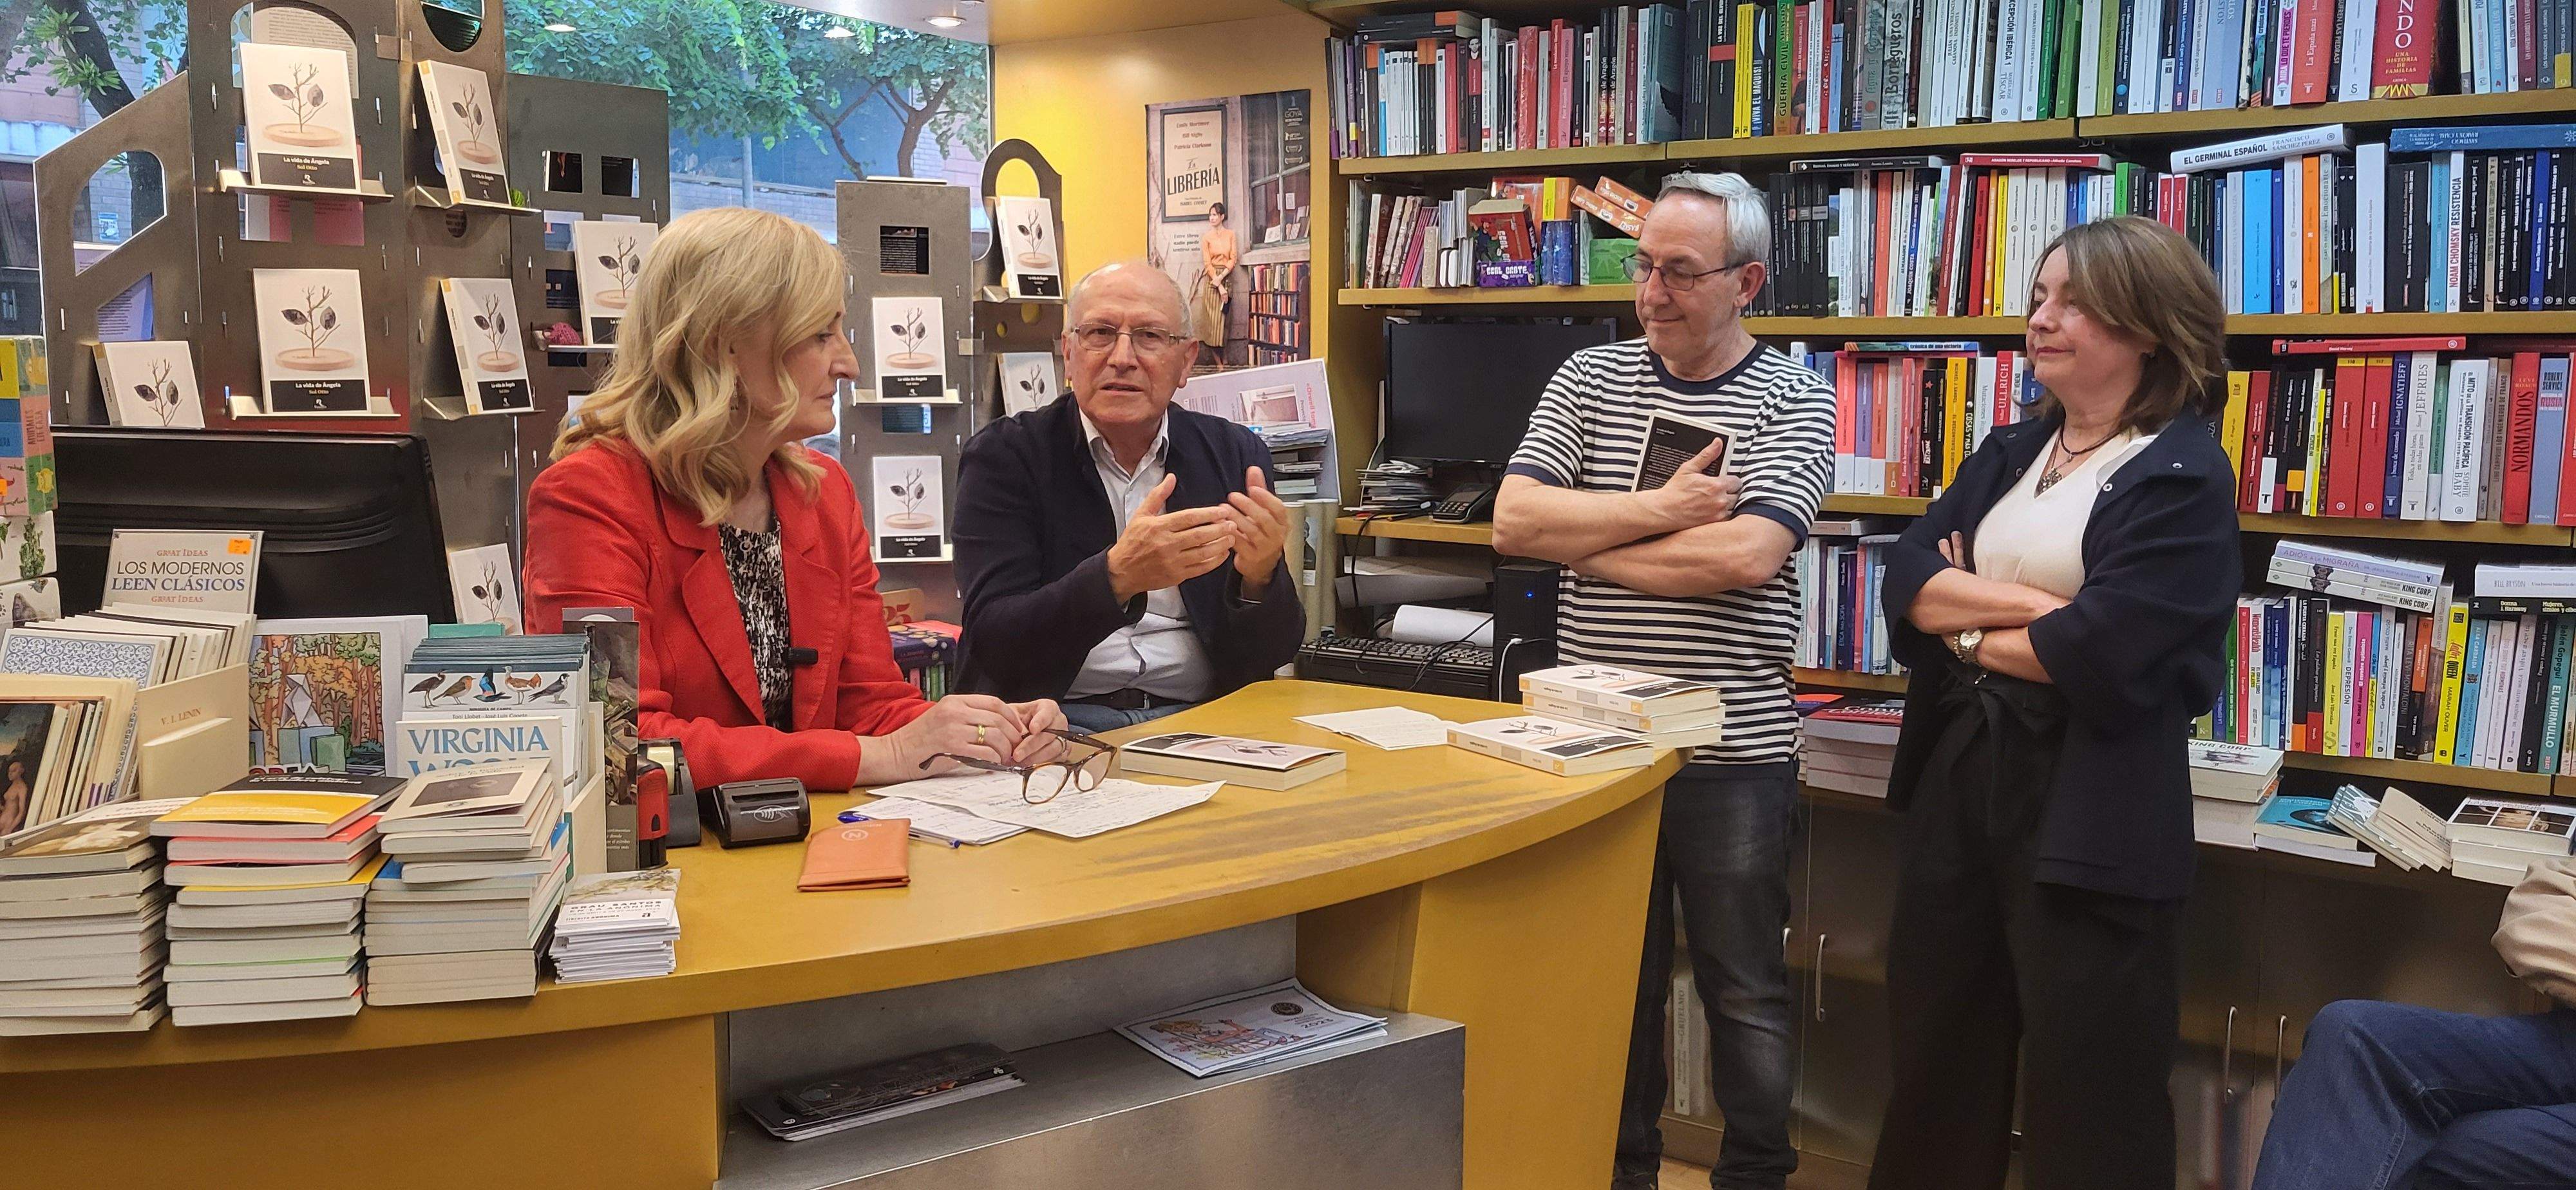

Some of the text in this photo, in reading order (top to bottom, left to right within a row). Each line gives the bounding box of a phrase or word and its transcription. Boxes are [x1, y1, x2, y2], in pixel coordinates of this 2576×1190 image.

[2282, 11, 2291, 36] PIERDES
[1884, 12, 1903, 95] Borregueros
[2280, 44, 2290, 57] QUE
[2307, 32, 2317, 55] España
[2280, 57, 2289, 66] LO
[2306, 56, 2314, 66] La
[1779, 44, 1788, 117] GUERRA CIVIL
[1998, 72, 2007, 100] TÍSCAR
[1752, 66, 1762, 124] ¡VIVA EL MAQUIS!
[2271, 134, 2310, 147] FRANCISCO
[2271, 137, 2321, 152] SÁNCHEZ PÉREZ
[311, 157, 330, 165] Ángela
[2183, 143, 2268, 166] EL GERMINAL ESPAÑOL
[1167, 163, 1220, 196] LIBRERÍA
[2448, 177, 2461, 288] NOAM CHOMSKY RESISTENCIA
[322, 381, 341, 390] Ángela
[1998, 363, 2009, 409] ULLRICH
[2395, 363, 2407, 409] IGNATIEFF
[2467, 377, 2476, 393] MITO
[2541, 381, 2563, 390] SERVICE
[2543, 372, 2563, 381] ROBERT
[2463, 404, 2473, 440] TRANSICIÓN
[2512, 391, 2534, 471] NORMANDOS
[2461, 441, 2472, 468] PACÍFICA
[2453, 471, 2462, 497] BABY
[117, 561, 245, 575] LOS MODERNOS
[2284, 549, 2307, 560] ADIÓS
[2322, 556, 2360, 570] MIGRAÑA
[111, 574, 245, 591] LEEN CLÁSICOS
[2401, 584, 2432, 596] KING CORP.
[2399, 598, 2412, 606] KING
[2553, 625, 2568, 679] Belén Gopegui
[2446, 661, 2459, 679] QUEEN
[2344, 666, 2352, 704] DEPRESIÓN
[2445, 686, 2453, 710] MARIAH
[178, 707, 202, 721] LENIN
[2545, 685, 2561, 748] EL MURMULLO
[408, 726, 549, 754] VIRGINIA
